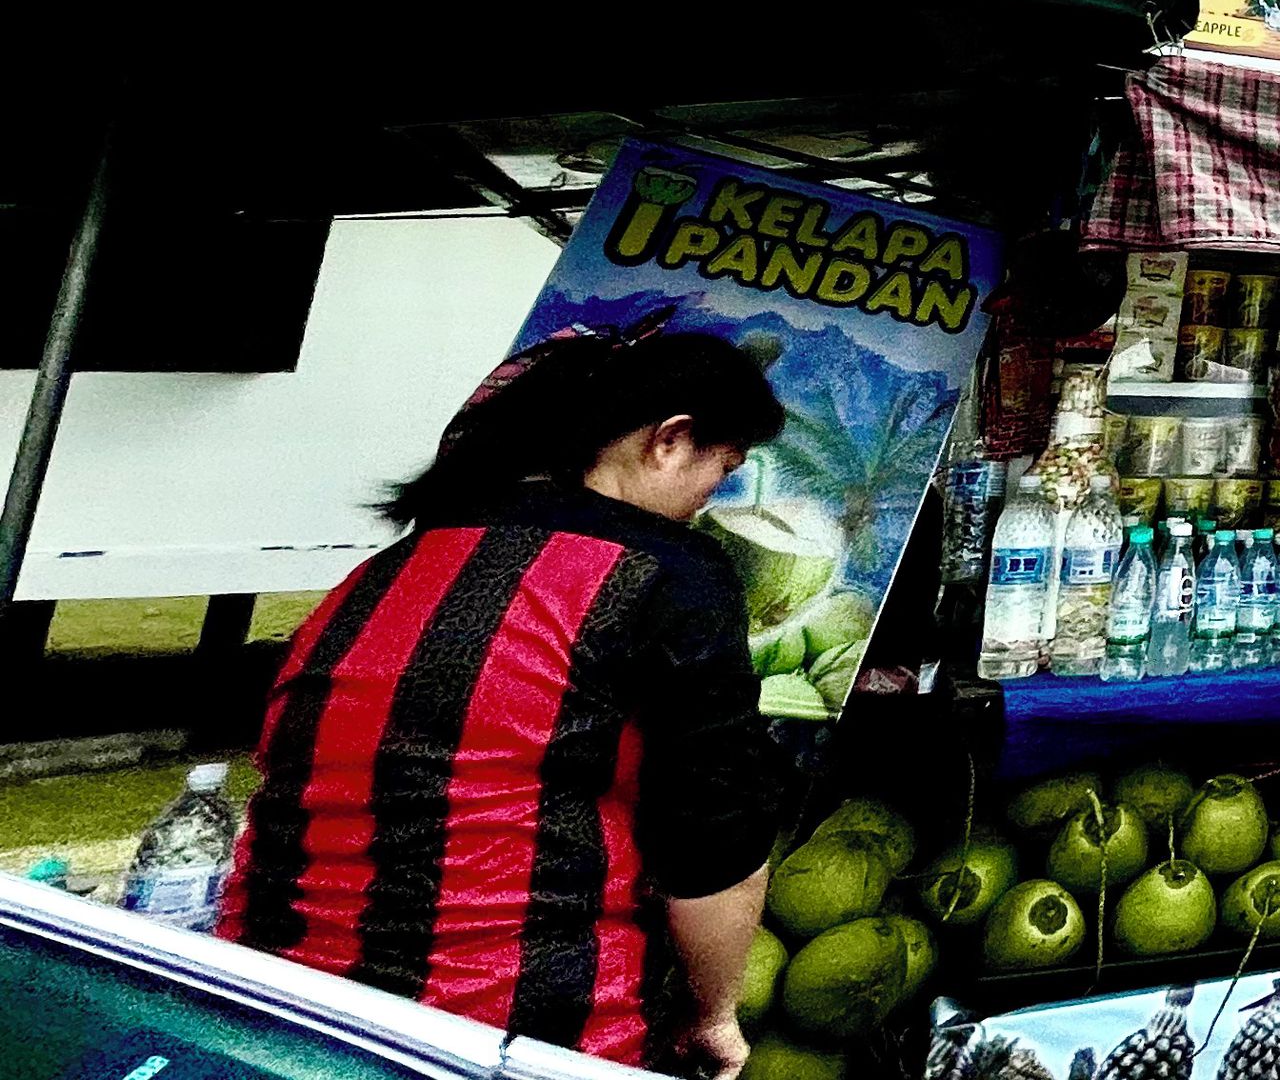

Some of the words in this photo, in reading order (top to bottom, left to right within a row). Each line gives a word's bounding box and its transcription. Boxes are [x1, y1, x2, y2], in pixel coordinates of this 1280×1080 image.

[1194, 20, 1242, 37] EAPPLE
[668, 224, 973, 329] PANDAN
[707, 181, 968, 281] KELAPA
